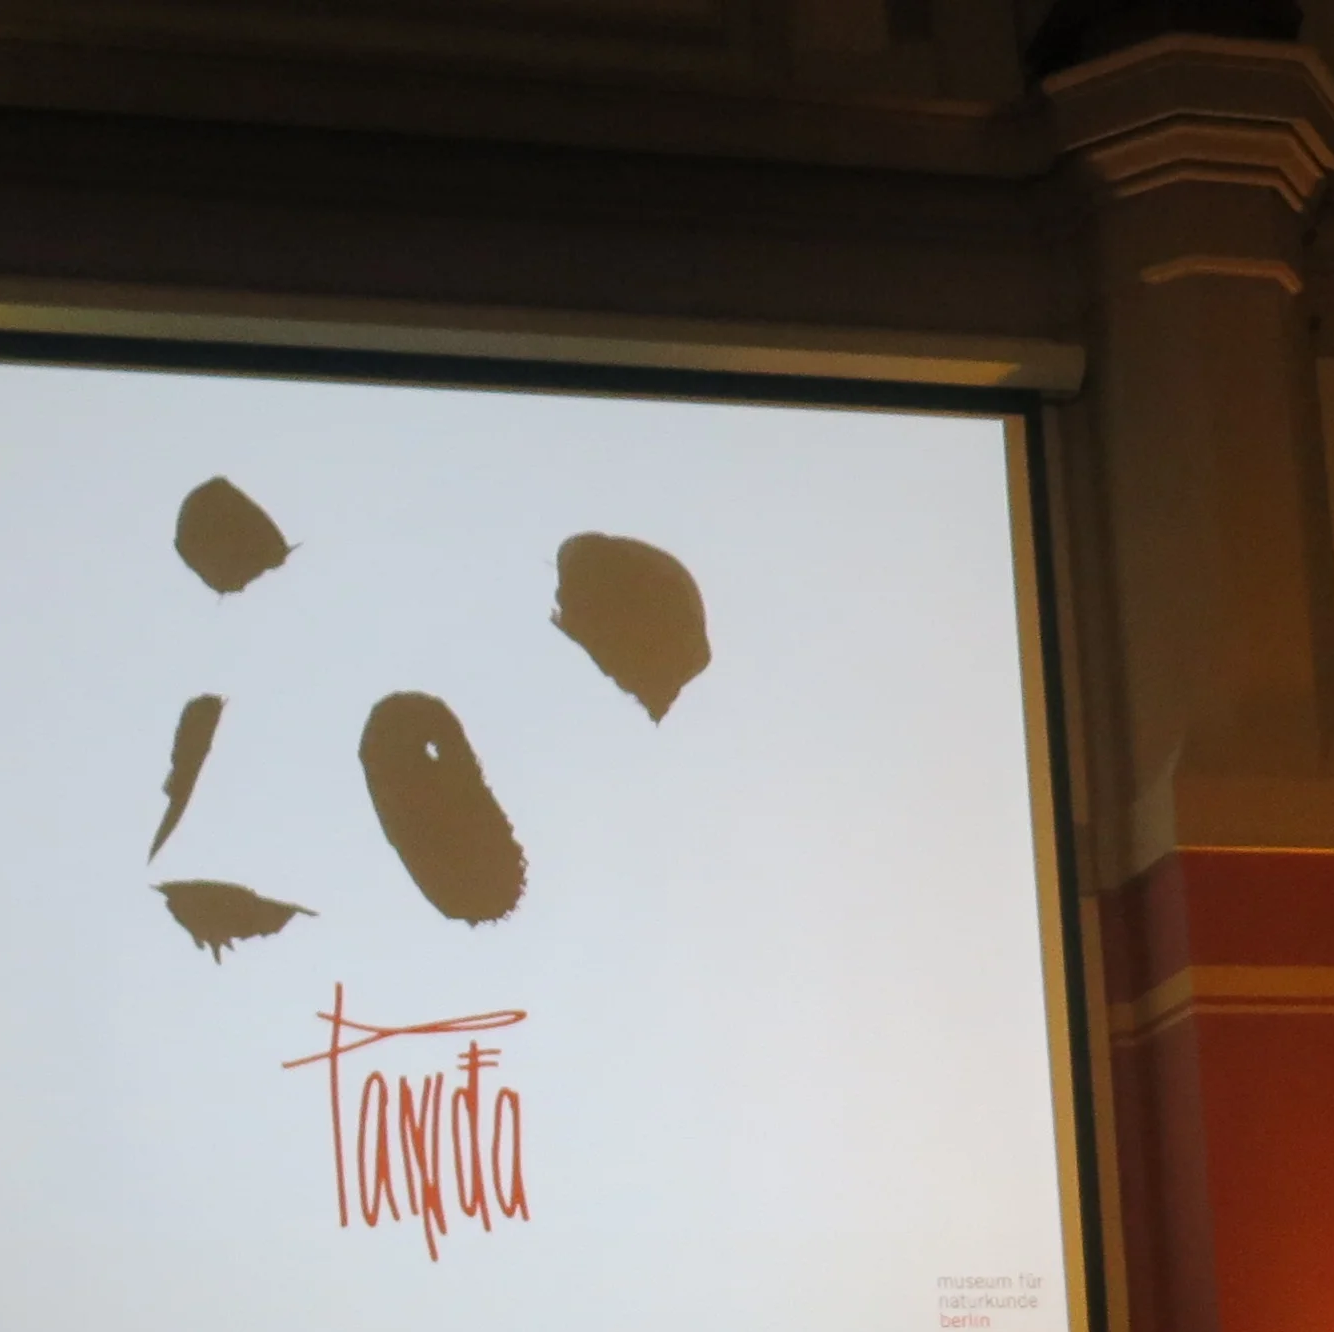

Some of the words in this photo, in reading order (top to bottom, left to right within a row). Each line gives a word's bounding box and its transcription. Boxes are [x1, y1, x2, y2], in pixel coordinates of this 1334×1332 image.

[937, 1275, 1013, 1290] museum
[1019, 1272, 1044, 1290] für
[938, 1292, 1040, 1309] naturkunde
[940, 1312, 991, 1329] berlin
